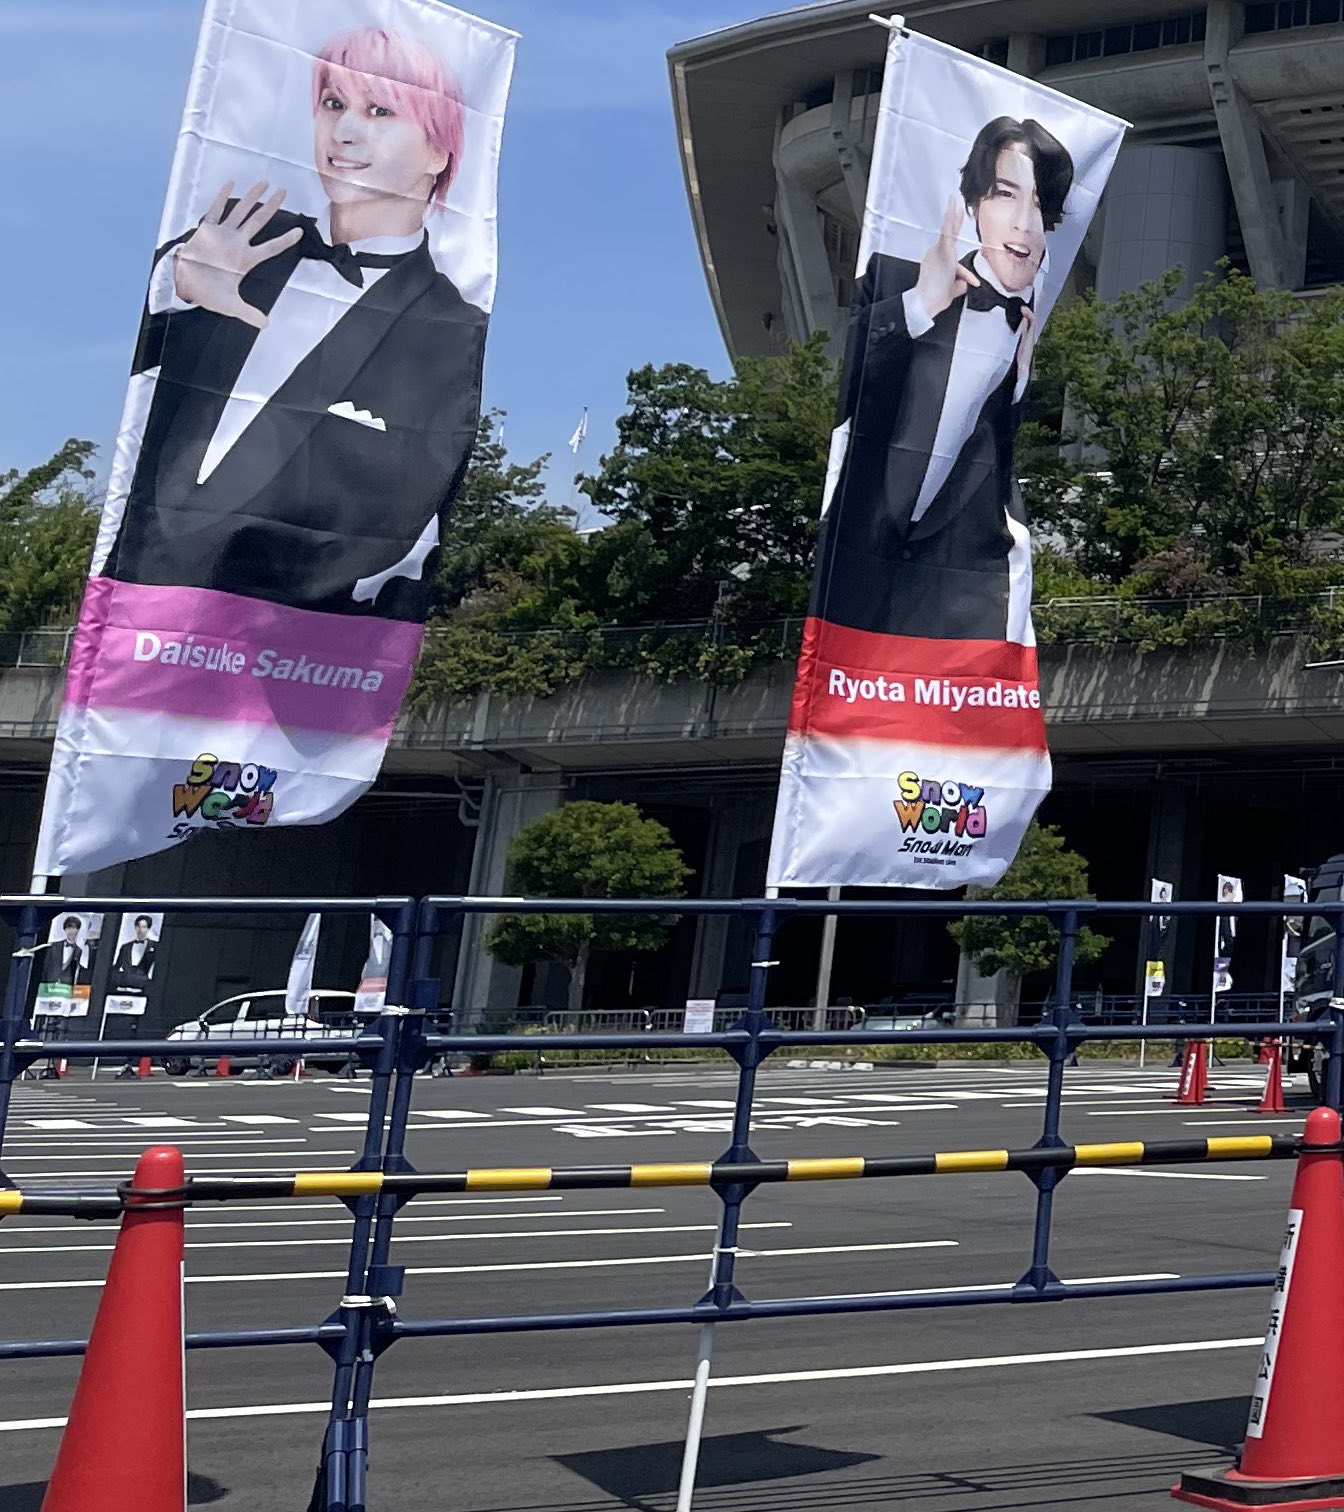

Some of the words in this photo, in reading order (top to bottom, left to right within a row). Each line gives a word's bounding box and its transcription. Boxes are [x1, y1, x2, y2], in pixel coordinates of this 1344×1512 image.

[134, 632, 246, 675] Daisuke
[251, 649, 384, 692] Sakuma
[828, 669, 906, 703] Ryota
[914, 678, 1041, 712] Miyadate
[186, 753, 278, 792] Snow
[897, 770, 984, 808] Snow
[893, 800, 987, 839] World
[897, 837, 943, 854] Snow
[941, 840, 974, 857] Man
